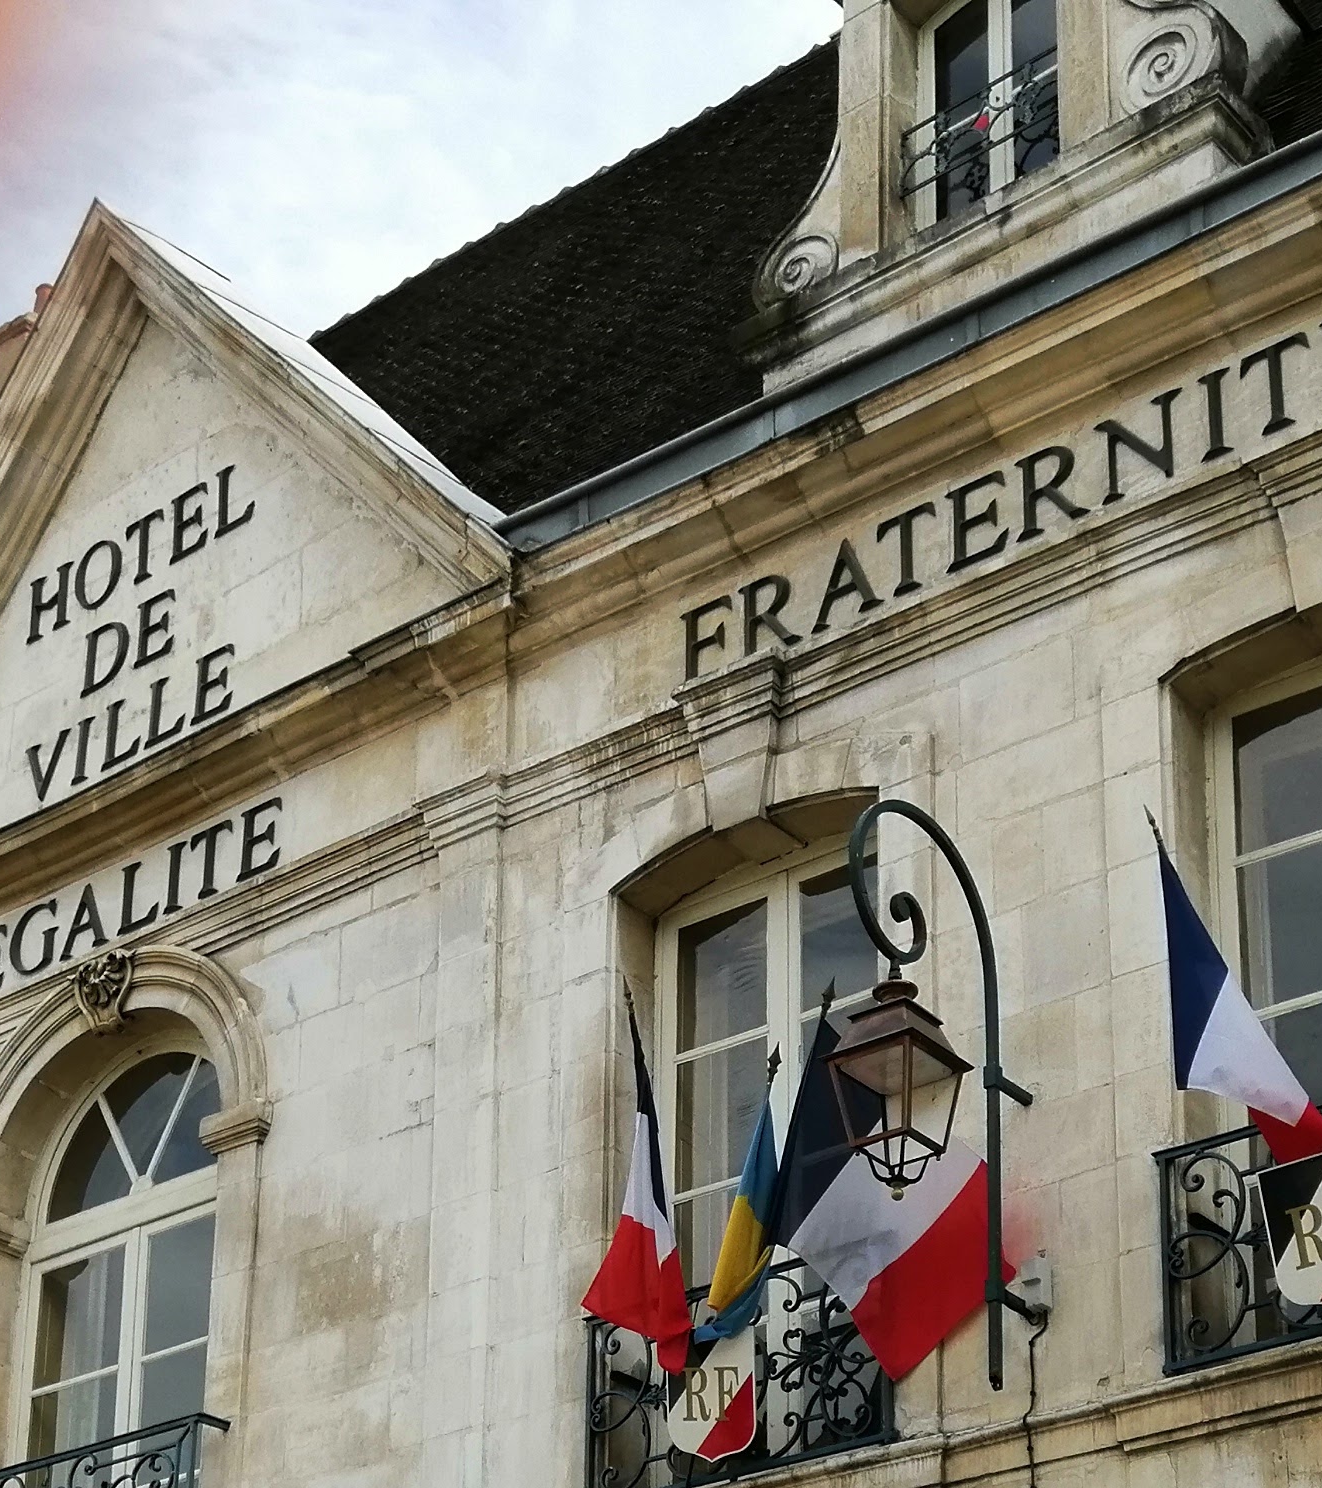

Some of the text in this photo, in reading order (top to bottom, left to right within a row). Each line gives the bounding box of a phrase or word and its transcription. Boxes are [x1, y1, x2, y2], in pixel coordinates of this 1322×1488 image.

[26, 464, 256, 646] HOTEL
[80, 588, 176, 699] DE
[25, 643, 236, 802] VILLE
[683, 1366, 740, 1422] RF
